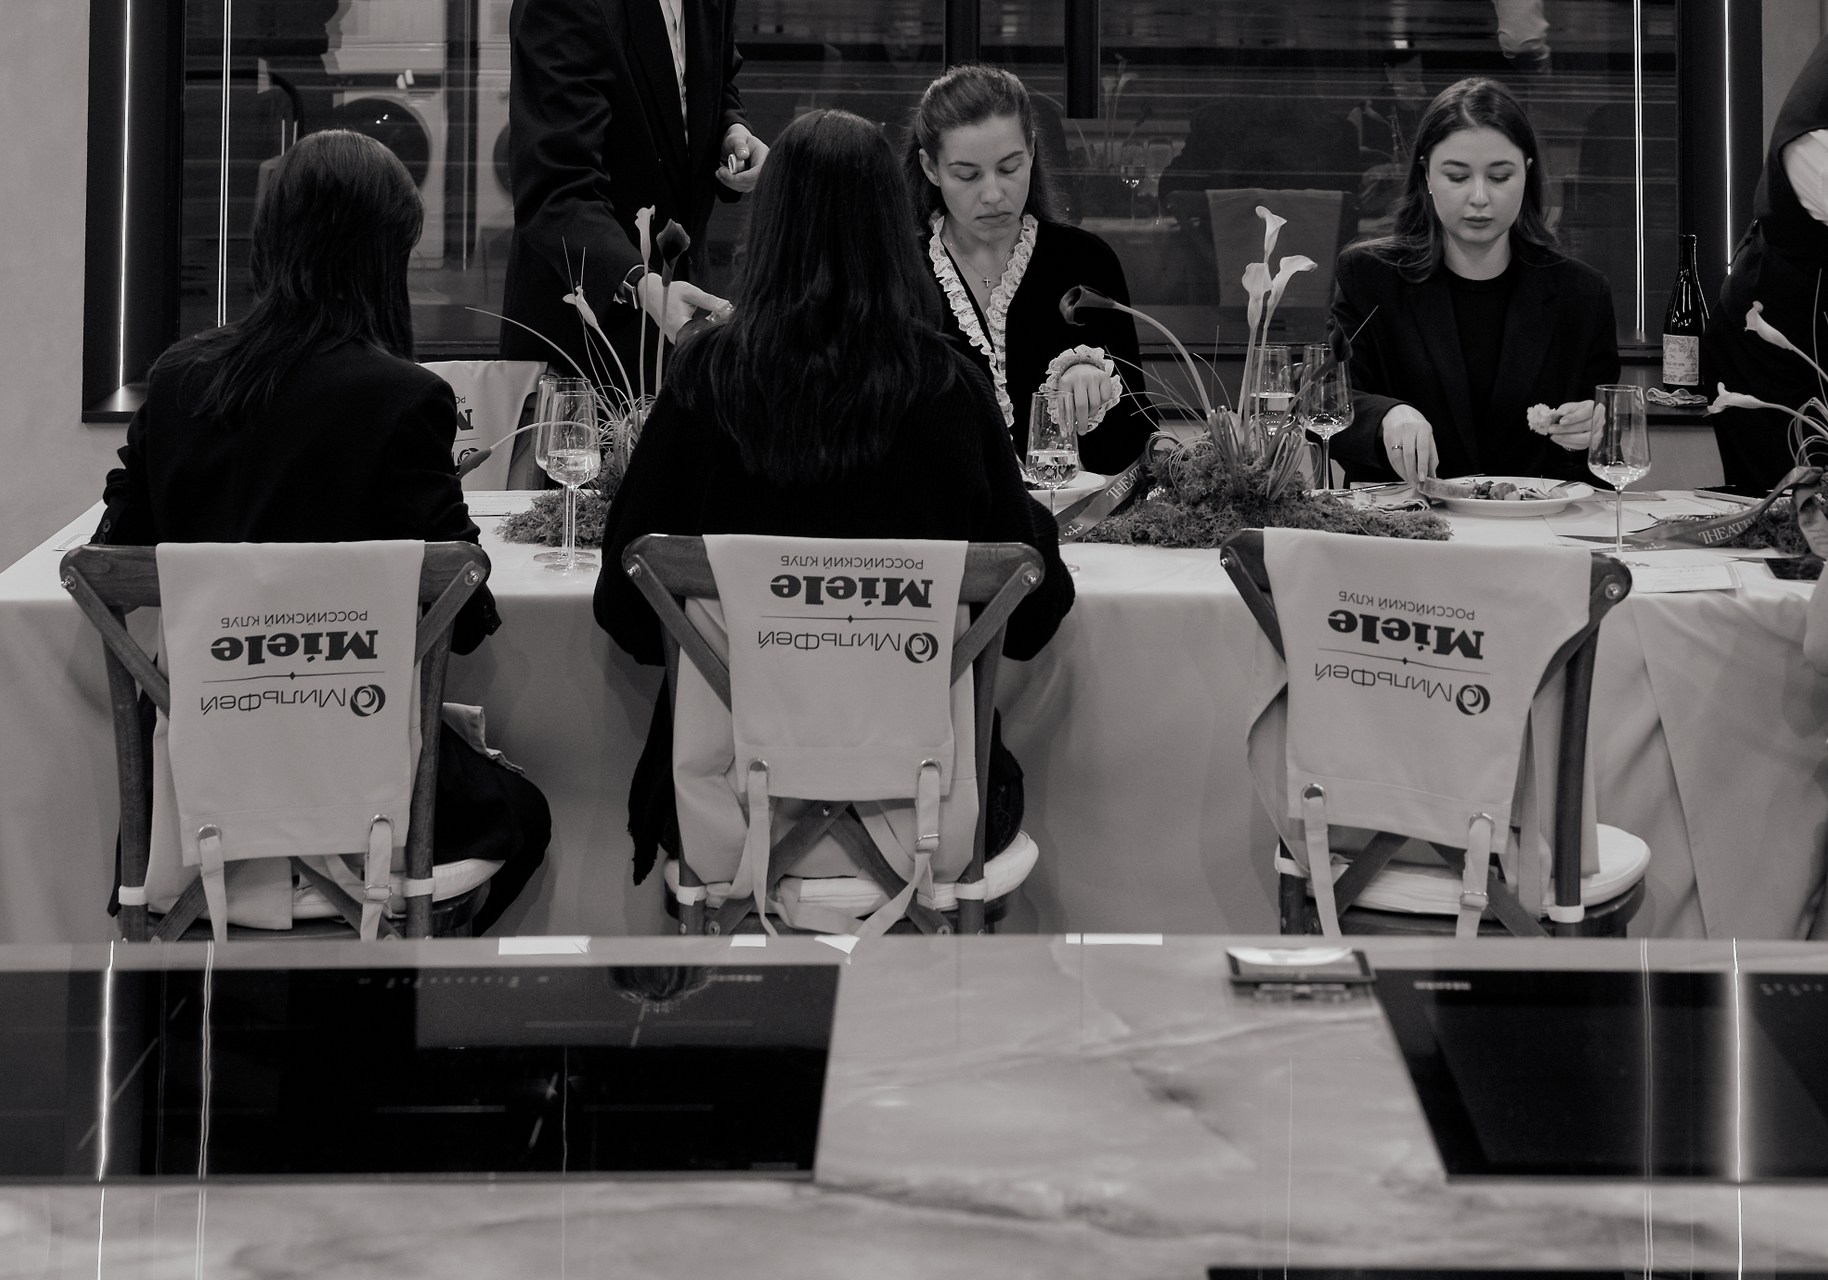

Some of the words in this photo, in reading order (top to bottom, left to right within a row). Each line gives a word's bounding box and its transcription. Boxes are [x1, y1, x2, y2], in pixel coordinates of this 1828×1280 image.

[780, 555, 818, 567] КЛУБ
[823, 556, 925, 570] РОССИЙСКИЙ
[770, 574, 934, 609] Miele
[1338, 590, 1374, 606] КЛУБ
[1378, 597, 1475, 621] РОССИЙСКИЙ
[220, 615, 260, 628] КЛУБ
[264, 610, 368, 628] РОССИЙСКИЙ
[1327, 609, 1485, 660] Miele
[210, 629, 379, 666] Miele
